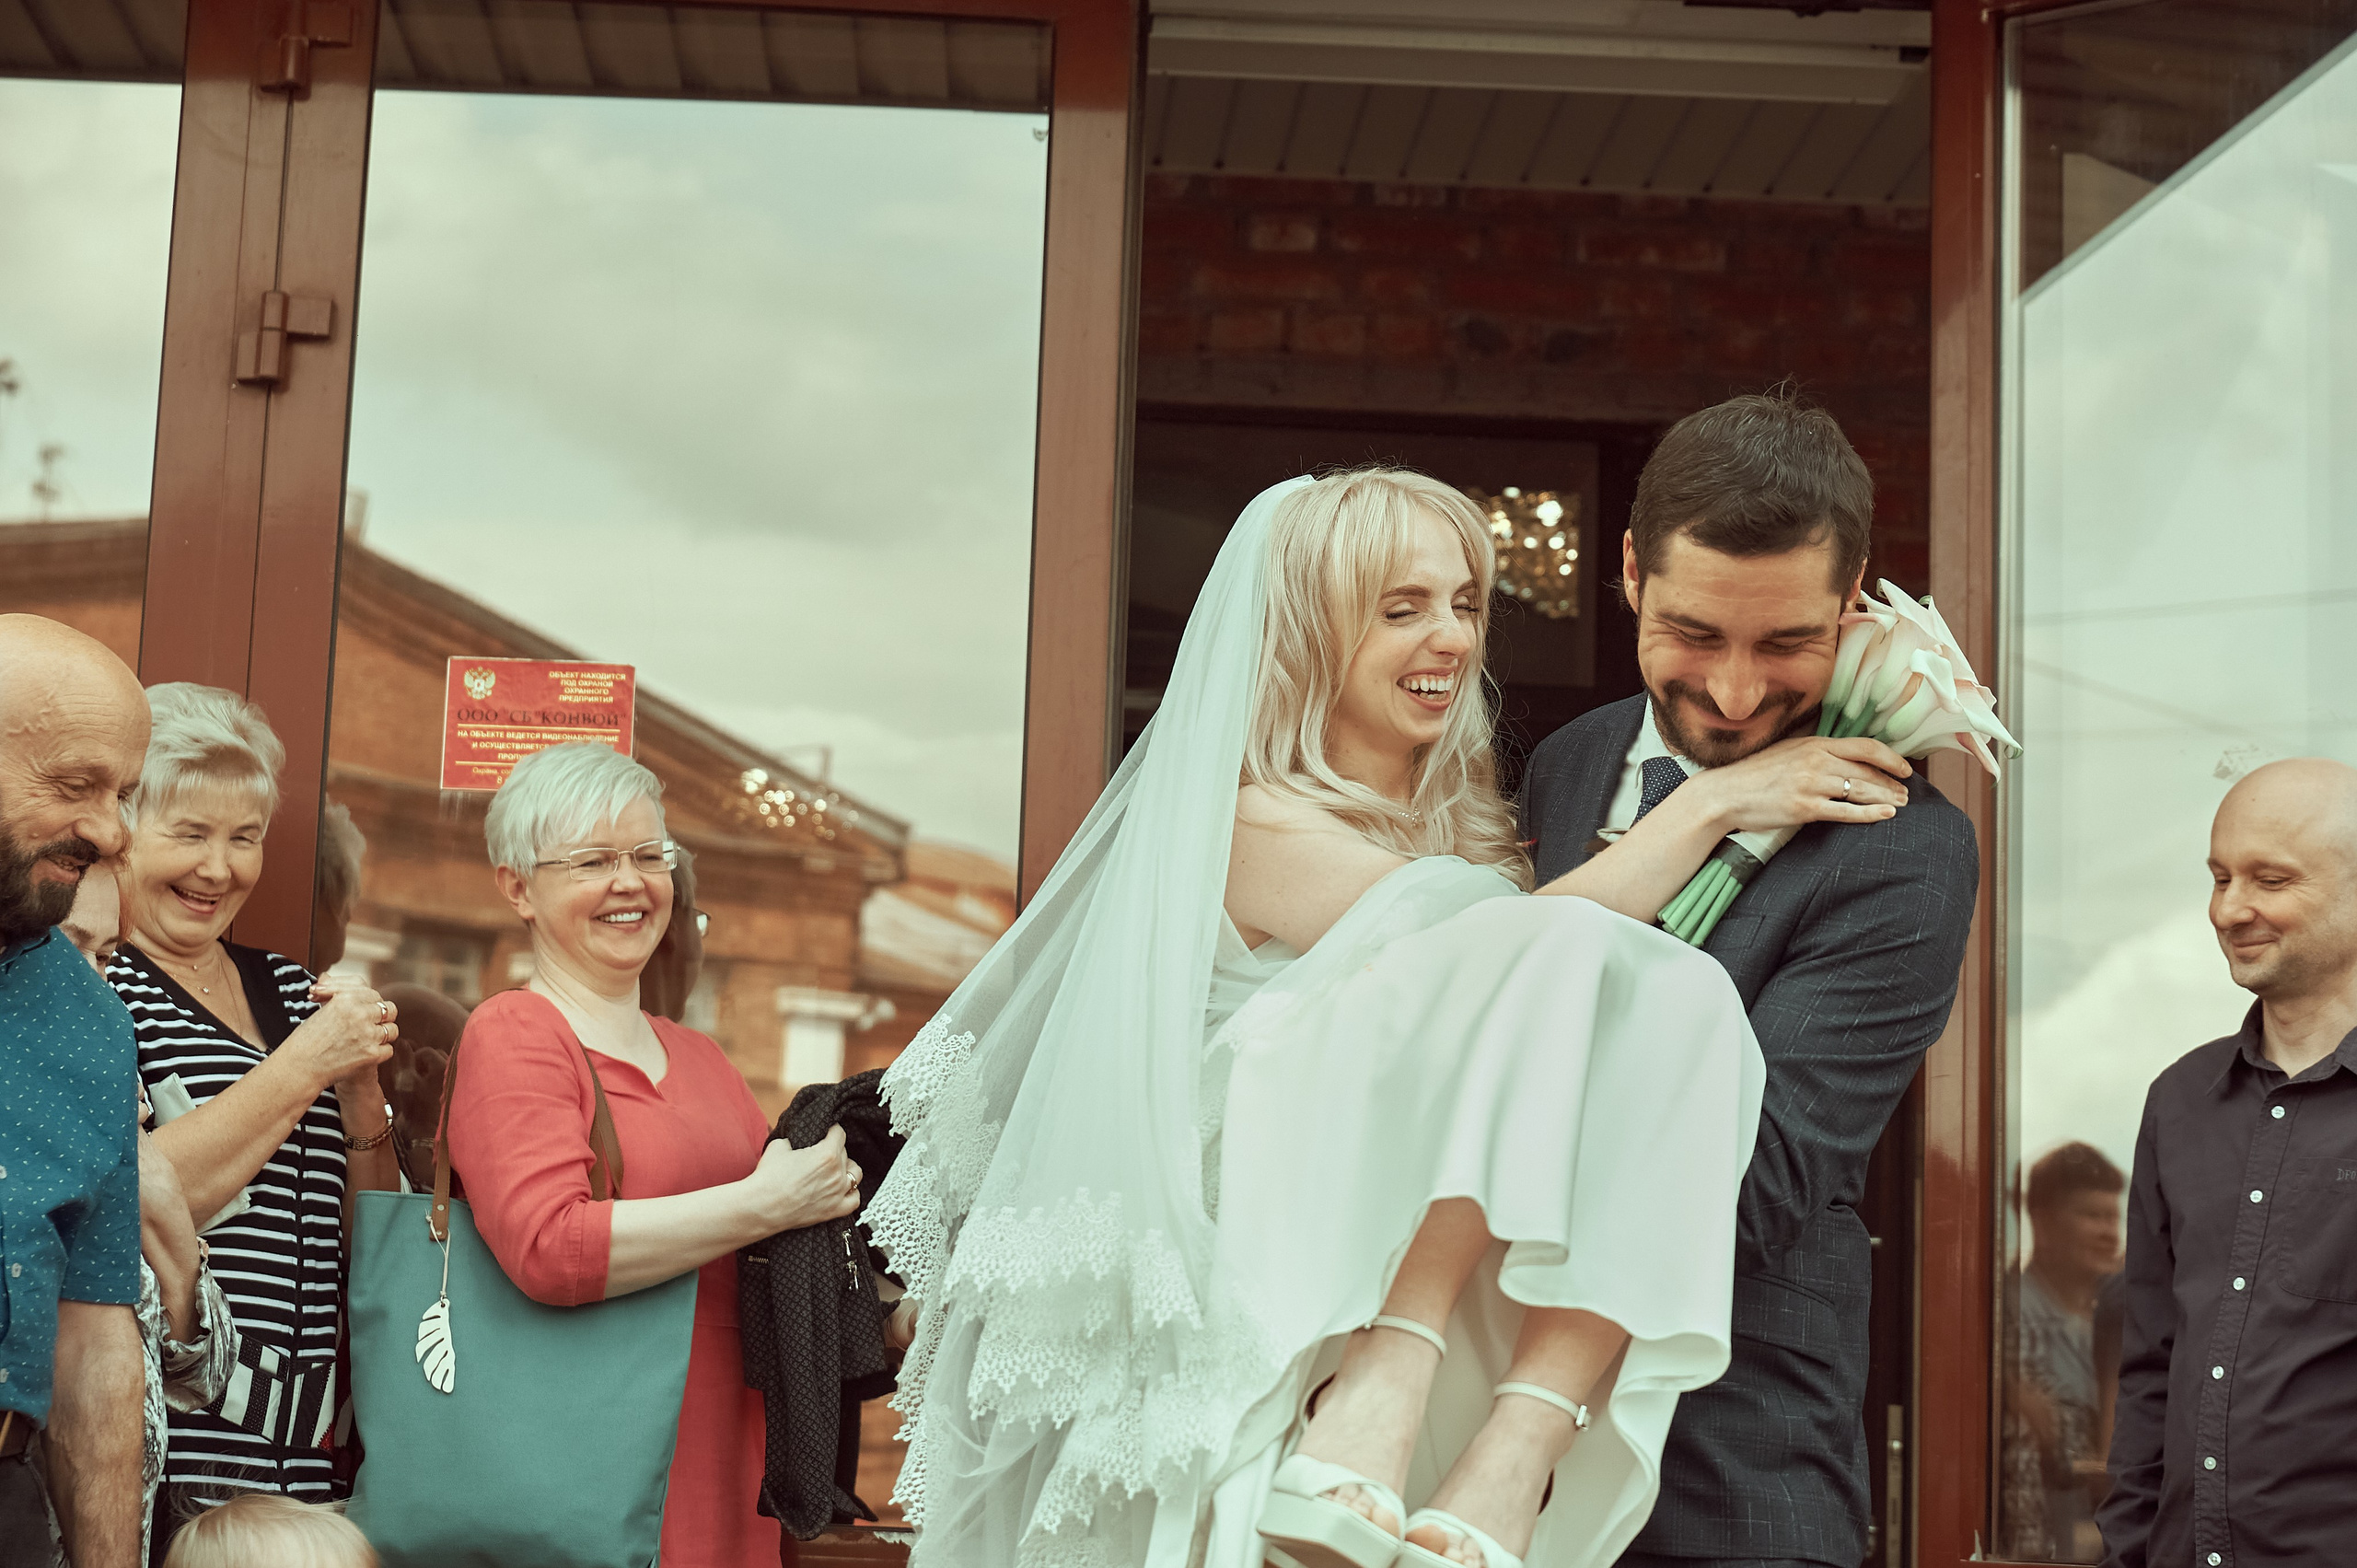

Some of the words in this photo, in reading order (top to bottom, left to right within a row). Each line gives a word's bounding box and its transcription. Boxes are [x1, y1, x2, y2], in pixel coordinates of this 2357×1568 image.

[580, 672, 626, 680] НАХОДИТСЯ
[564, 687, 610, 695] ОХРАННОГО
[559, 694, 614, 703] ПРЕДПРИЯТИЯ
[457, 707, 498, 722] ООО
[470, 730, 505, 738] ОБЪЕКТЕ
[506, 731, 540, 740] ВЕДЕТСЯ
[498, 752, 527, 761] ПРОПУ
